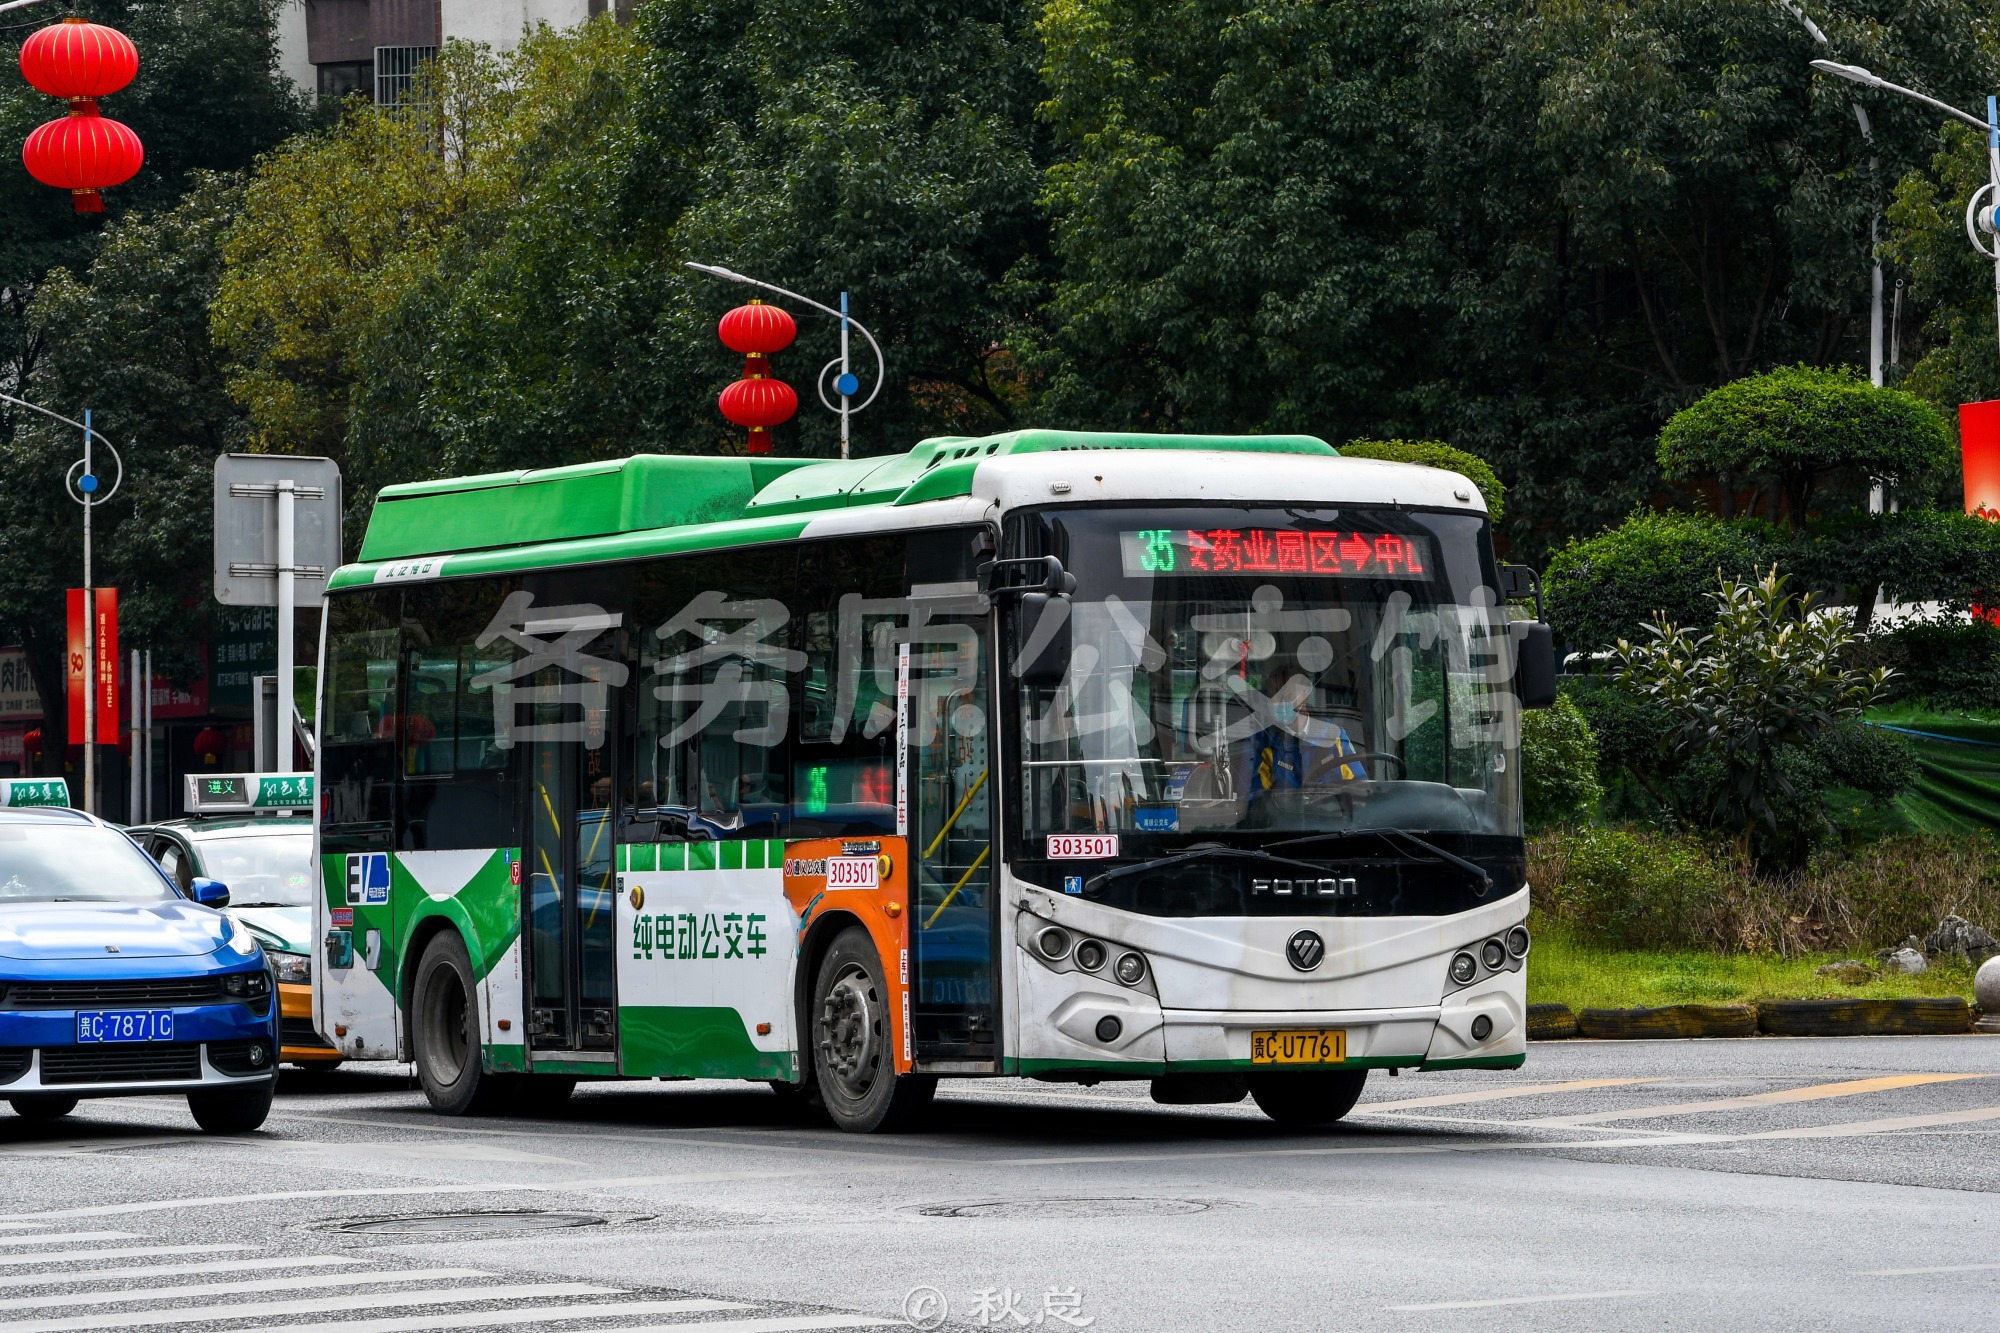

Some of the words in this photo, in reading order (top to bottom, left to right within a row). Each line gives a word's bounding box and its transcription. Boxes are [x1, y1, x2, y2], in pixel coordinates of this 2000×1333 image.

[1138, 529, 1175, 572] 35
[208, 780, 236, 794] 遵义
[1052, 839, 1112, 855] 303501
[831, 862, 874, 883] 303501
[1252, 878, 1358, 896] FOTON
[633, 912, 767, 960] 纯电动公交车
